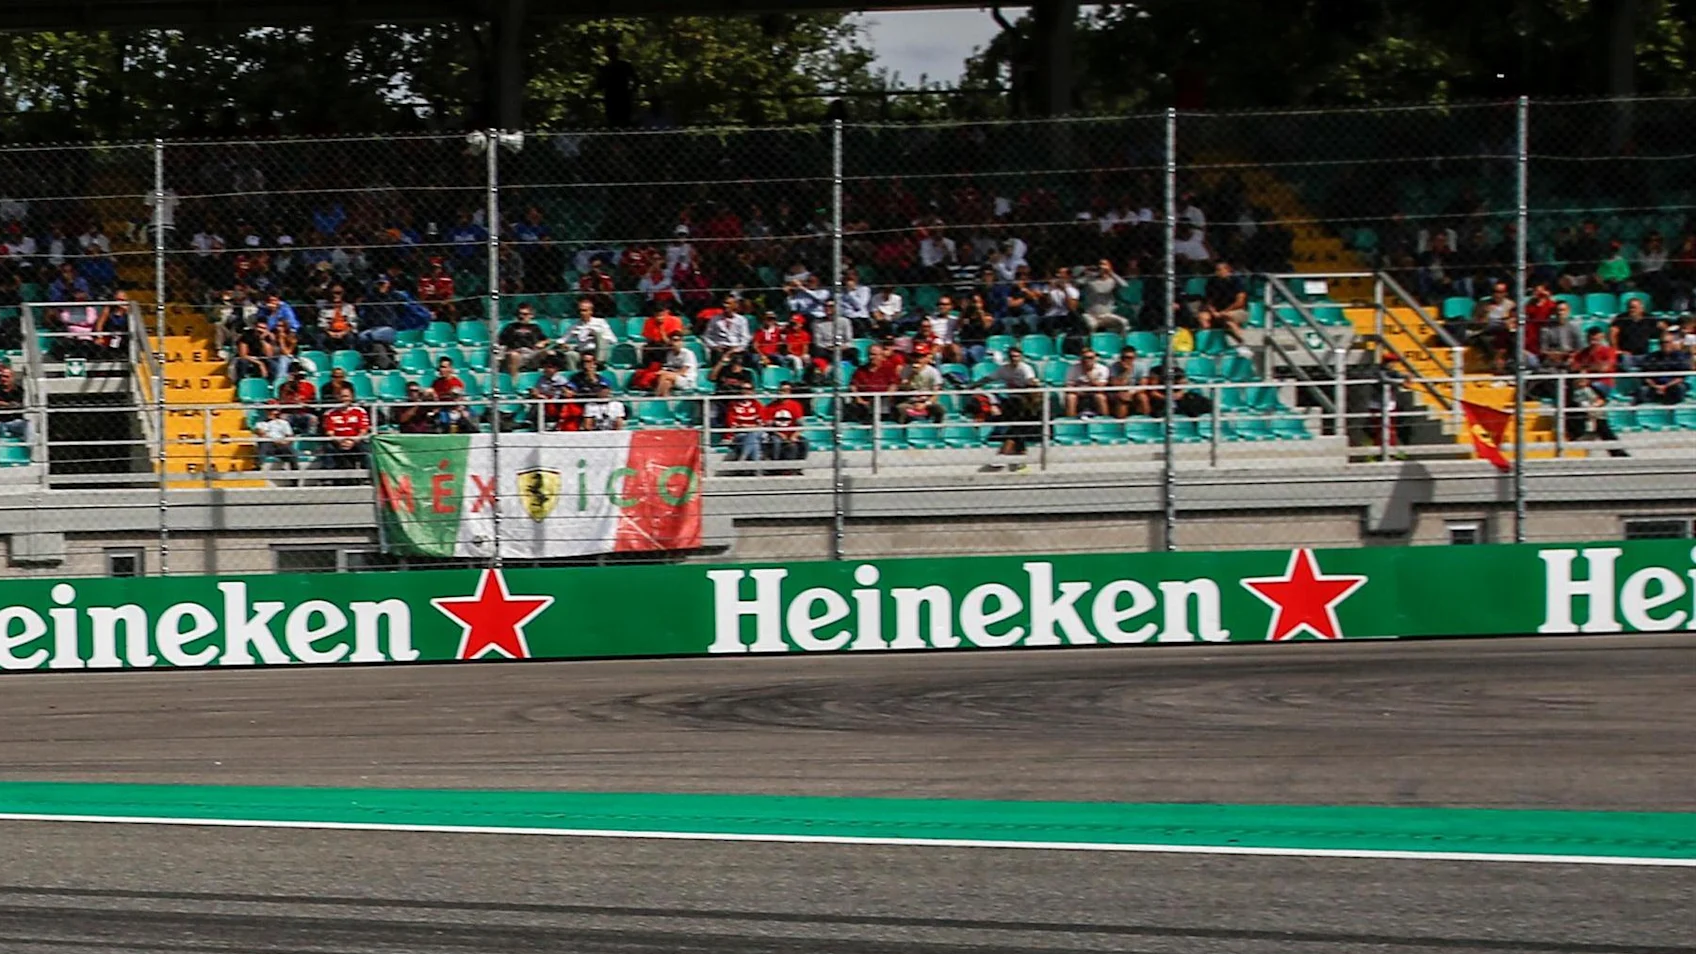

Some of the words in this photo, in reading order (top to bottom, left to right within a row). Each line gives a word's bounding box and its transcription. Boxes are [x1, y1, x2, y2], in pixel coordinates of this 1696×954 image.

[152, 351, 183, 363] FLA
[191, 351, 202, 362] E
[200, 378, 211, 390] D
[707, 562, 1230, 654] Heineken
[1538, 546, 1696, 634] He
